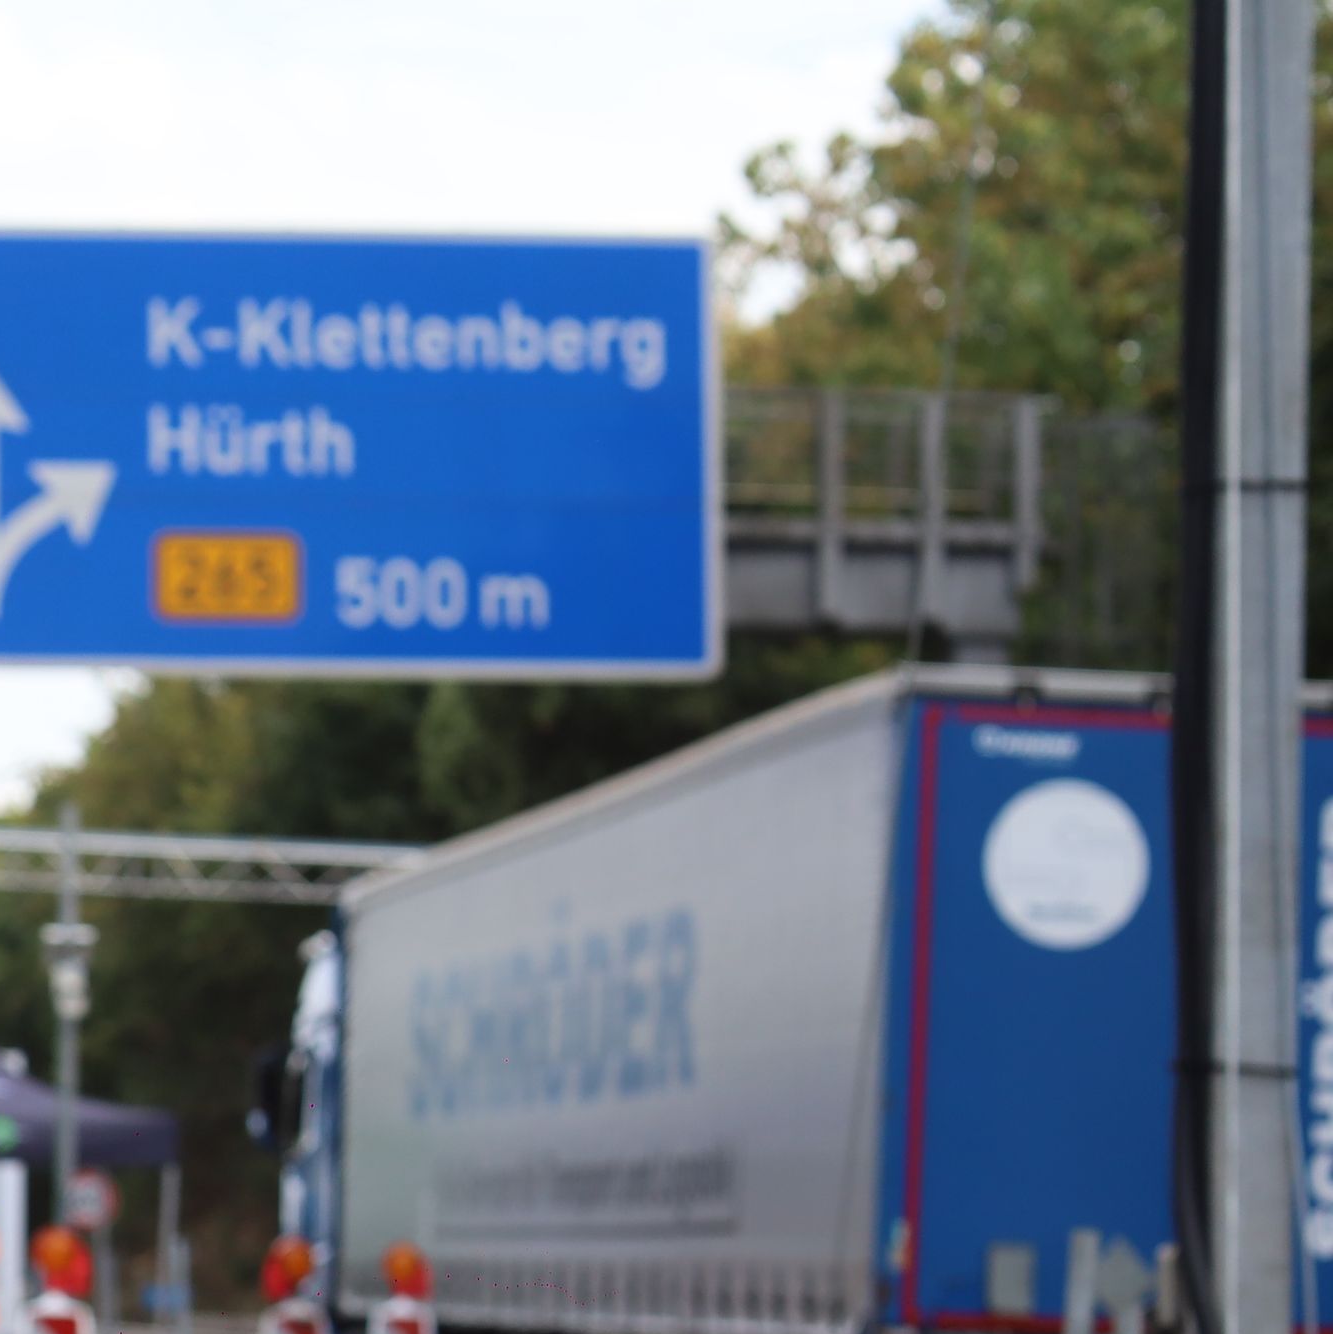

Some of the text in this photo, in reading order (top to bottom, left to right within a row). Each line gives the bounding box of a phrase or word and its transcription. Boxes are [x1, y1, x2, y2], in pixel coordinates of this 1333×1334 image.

[147, 298, 665, 389] K-Klettenberg
[147, 403, 355, 476] Hürth
[335, 556, 550, 629] 500 m
[407, 893, 699, 1120] SCHRÖDER
